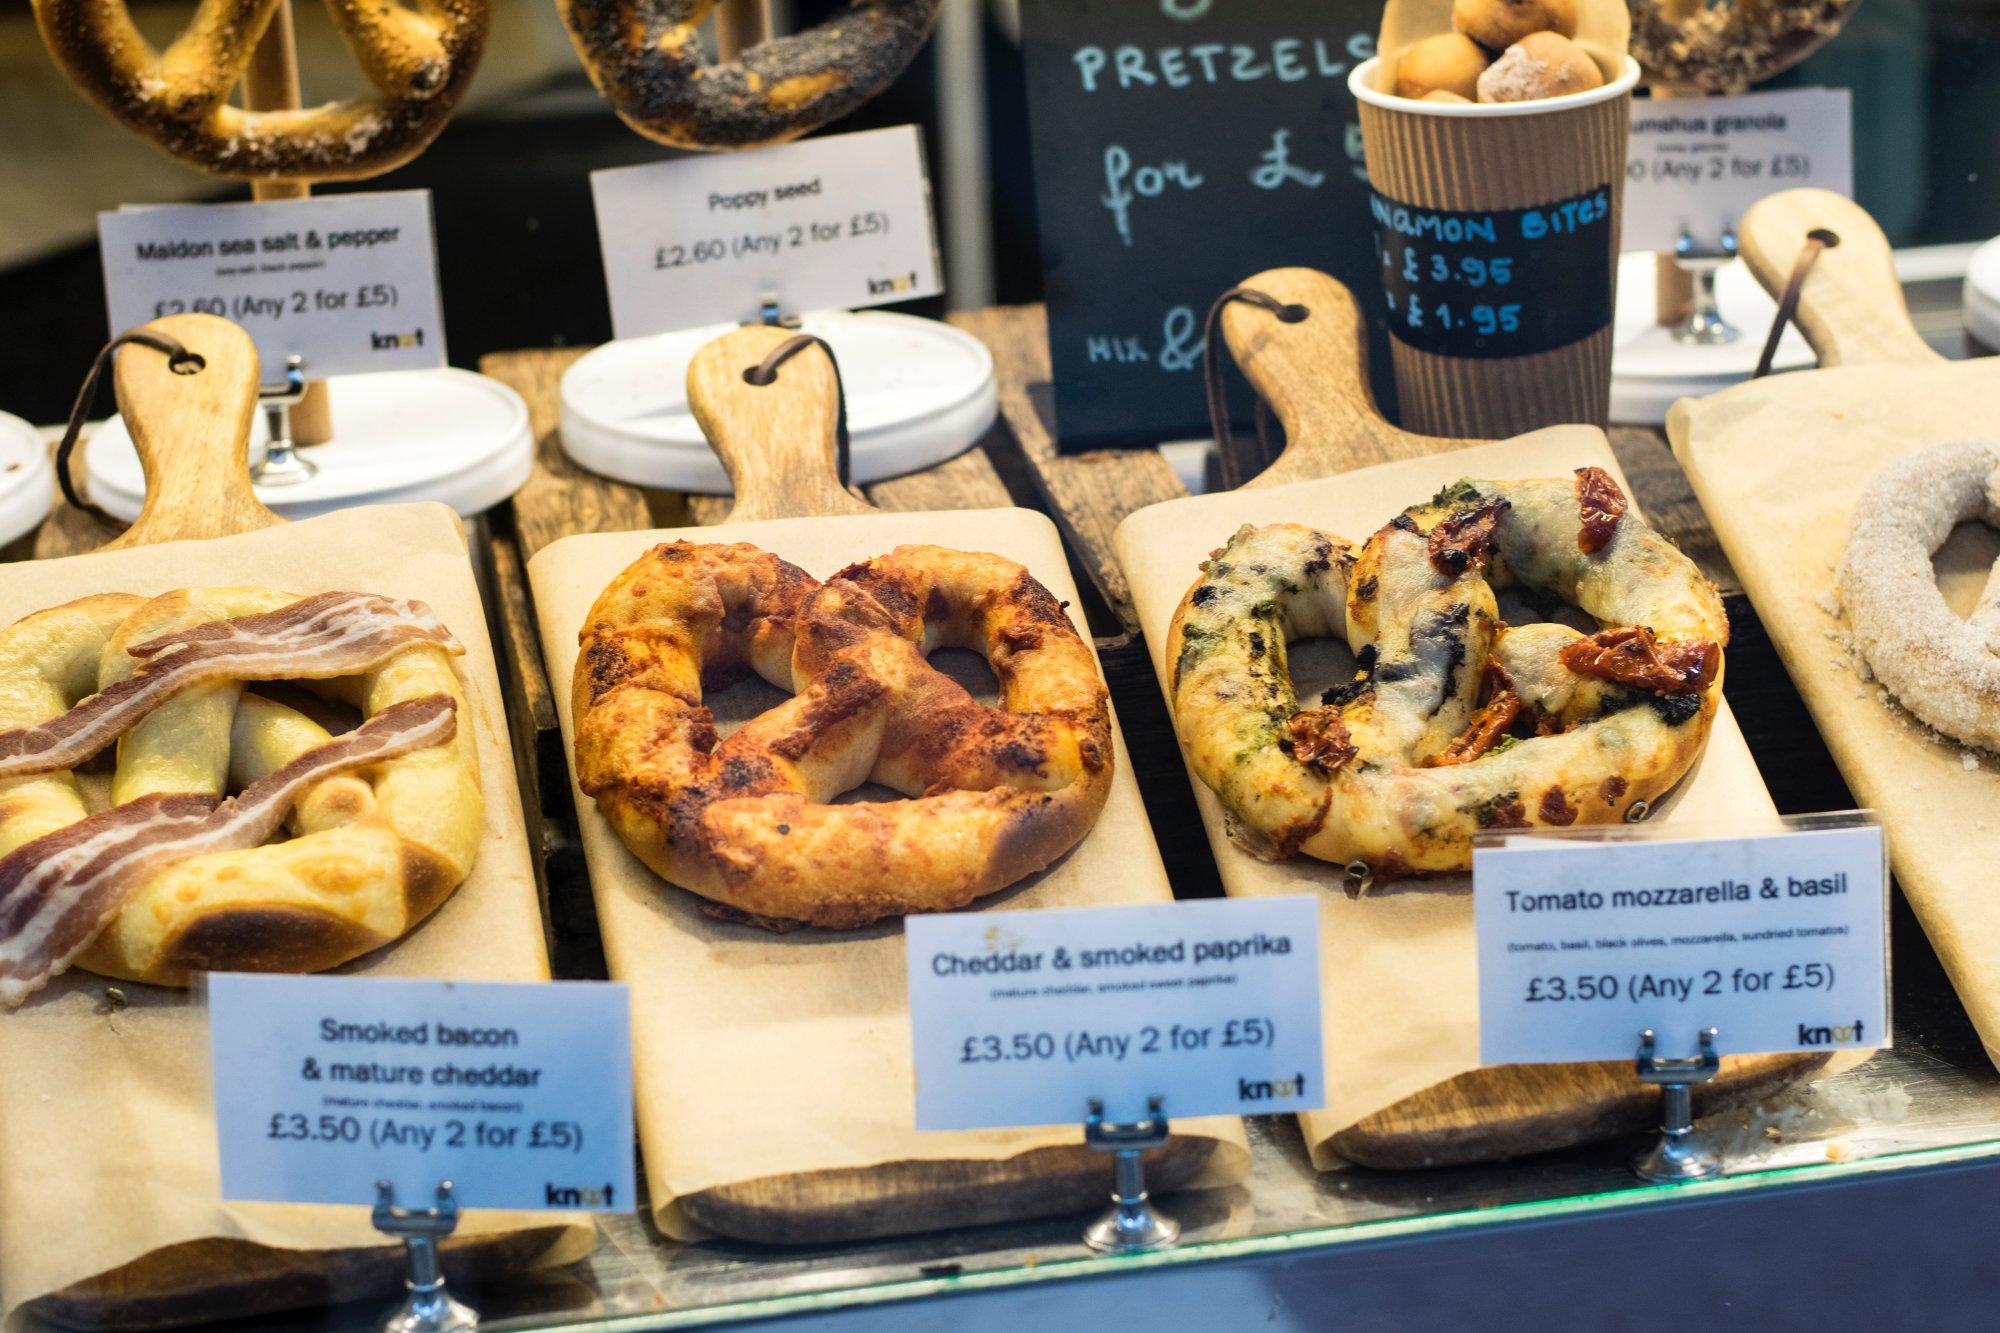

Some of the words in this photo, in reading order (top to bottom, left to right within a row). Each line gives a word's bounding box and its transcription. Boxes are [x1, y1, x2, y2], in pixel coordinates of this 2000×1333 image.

[1073, 34, 1376, 92] PRETZELS
[1711, 111, 1786, 136] granola
[1653, 157, 1701, 183] (Any
[1709, 156, 1725, 179] 2
[1731, 154, 1763, 178] for
[1770, 152, 1811, 178] £5)
[708, 190, 768, 212] Poppy
[774, 179, 821, 201] seed
[1103, 145, 1203, 247] for
[136, 240, 213, 261] Maldon
[218, 238, 256, 256] sea
[261, 230, 299, 253] salt
[306, 230, 322, 249] &
[328, 227, 400, 250] pepper
[654, 240, 725, 270] £2.60
[732, 233, 781, 260] (Any
[788, 226, 804, 246] 2
[811, 222, 842, 244] for
[850, 212, 890, 237] £5)
[154, 297, 227, 319] £260
[233, 293, 282, 319] (Any
[292, 292, 307, 313] 2
[315, 289, 347, 311] for
[356, 284, 398, 308] £5)
[1158, 305, 1208, 372] &
[1505, 888, 1604, 913] Tomato
[1612, 880, 1751, 909] mozzarella
[1759, 877, 1780, 901] &
[1788, 872, 1848, 898] basil
[931, 951, 1046, 977] Cheddar
[1053, 946, 1073, 971] &
[1080, 939, 1185, 969] smoked
[1193, 932, 1291, 965] paprika
[1595, 936, 1627, 949] black
[1742, 928, 1794, 941] sundried
[1524, 974, 1618, 1003] £3.50
[1628, 971, 1694, 1003] (Any
[1702, 970, 1722, 996] 2
[1732, 966, 1774, 993] for
[1781, 962, 1835, 992] £5)
[320, 1017, 428, 1044] Smoked
[438, 1022, 519, 1047] bacon
[959, 1031, 1055, 1064] £3.50
[1064, 1028, 1131, 1061] (Any
[1140, 1026, 1160, 1053] 2
[1170, 1022, 1212, 1050] for
[1220, 1017, 1275, 1049] £5)
[302, 1057, 321, 1081] &
[329, 1060, 424, 1085] mature
[432, 1062, 541, 1087] cheddar
[267, 1112, 361, 1143] £3.50
[370, 1118, 435, 1152] (Any
[445, 1120, 465, 1148] 2
[475, 1119, 518, 1148] for
[526, 1120, 584, 1151] £5)
